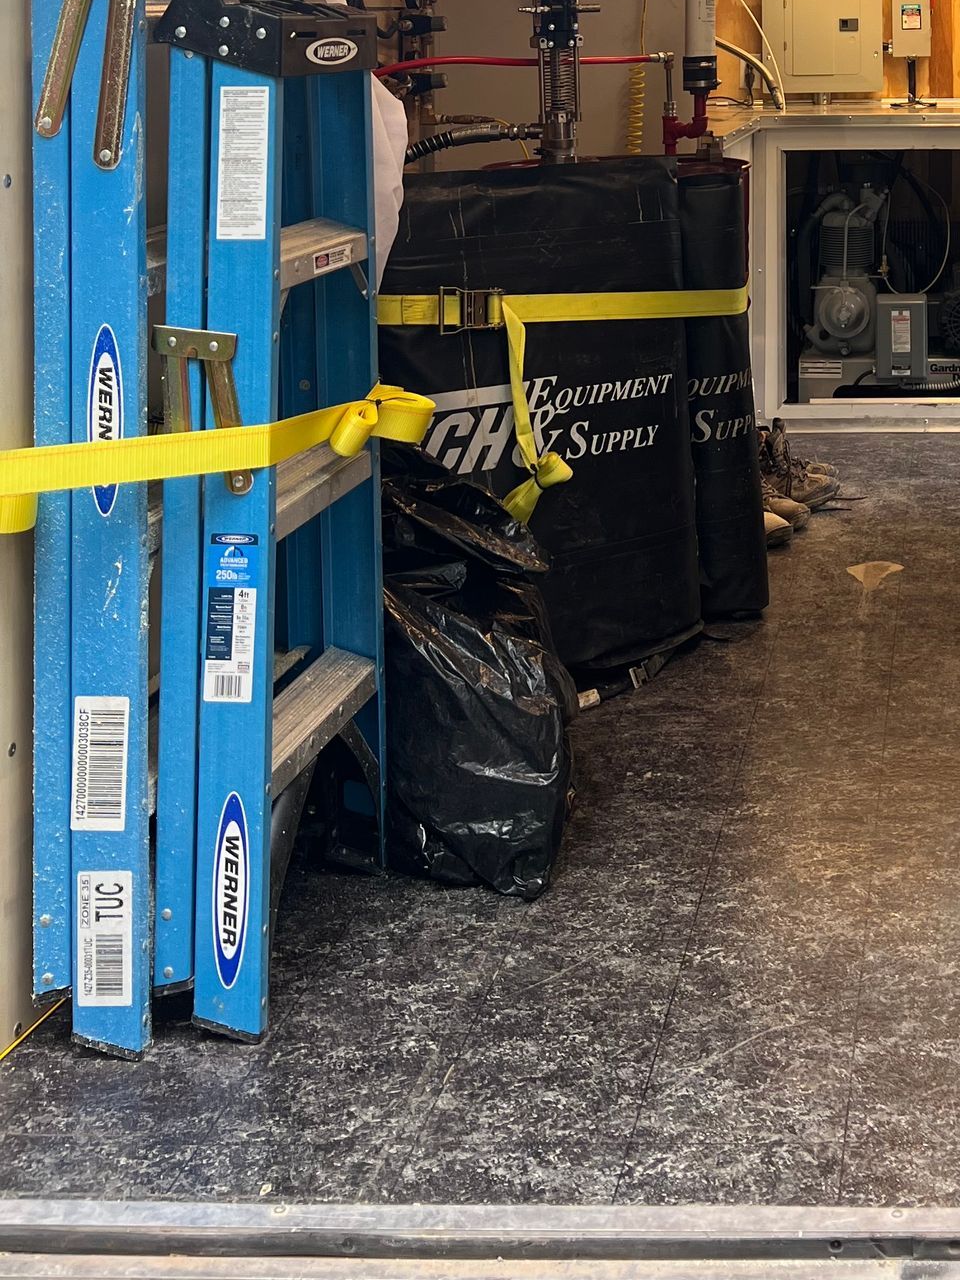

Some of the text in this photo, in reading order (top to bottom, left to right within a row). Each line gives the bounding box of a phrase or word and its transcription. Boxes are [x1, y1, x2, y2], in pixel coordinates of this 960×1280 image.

[317, 45, 349, 58] WERNER
[98, 367, 113, 441] WERN
[566, 420, 659, 460] SUPPLY
[216, 569, 238, 580] 250lb
[238, 589, 249, 598] 4ft
[82, 879, 89, 892] 35
[222, 835, 240, 949] WERNER
[95, 883, 124, 922] TUC
